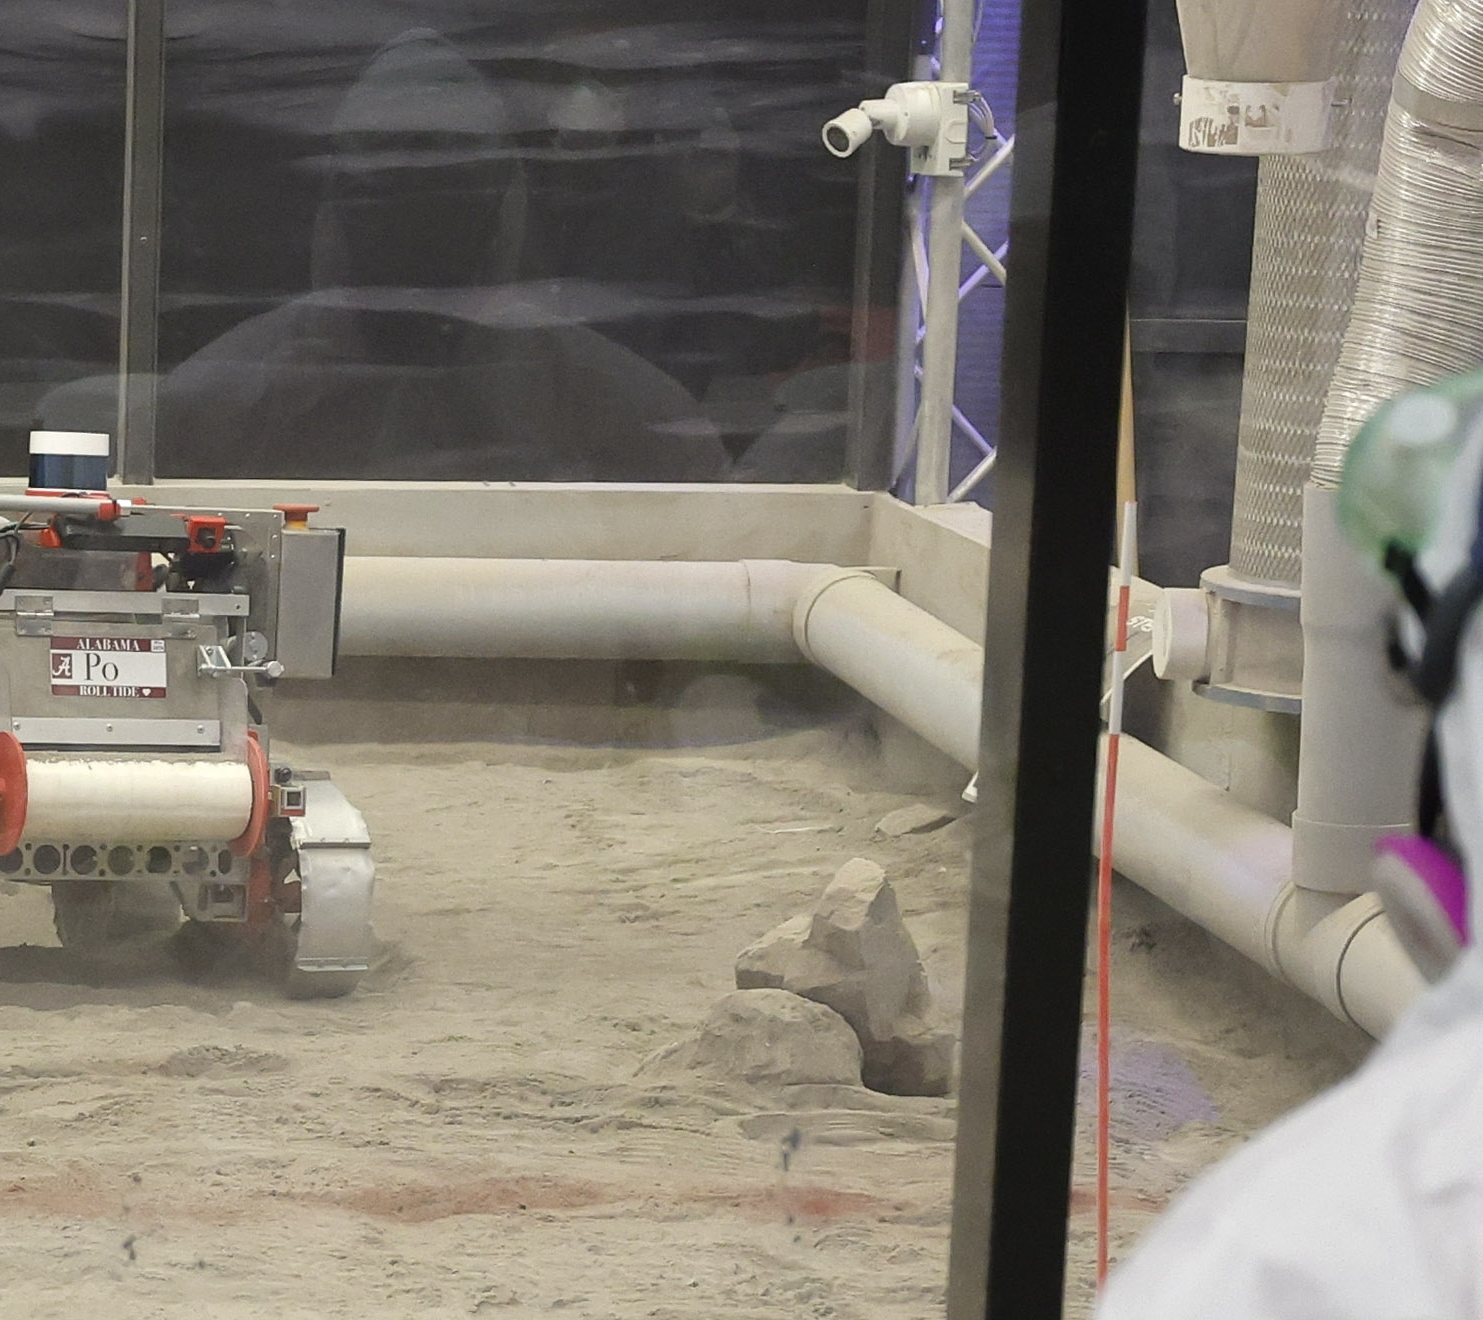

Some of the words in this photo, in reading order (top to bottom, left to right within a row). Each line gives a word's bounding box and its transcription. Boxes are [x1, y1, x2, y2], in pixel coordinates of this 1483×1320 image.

[77, 638, 140, 651] ALABAMA
[84, 652, 119, 681] Po
[79, 685, 110, 696] ROLL
[111, 686, 139, 697] TIDE
